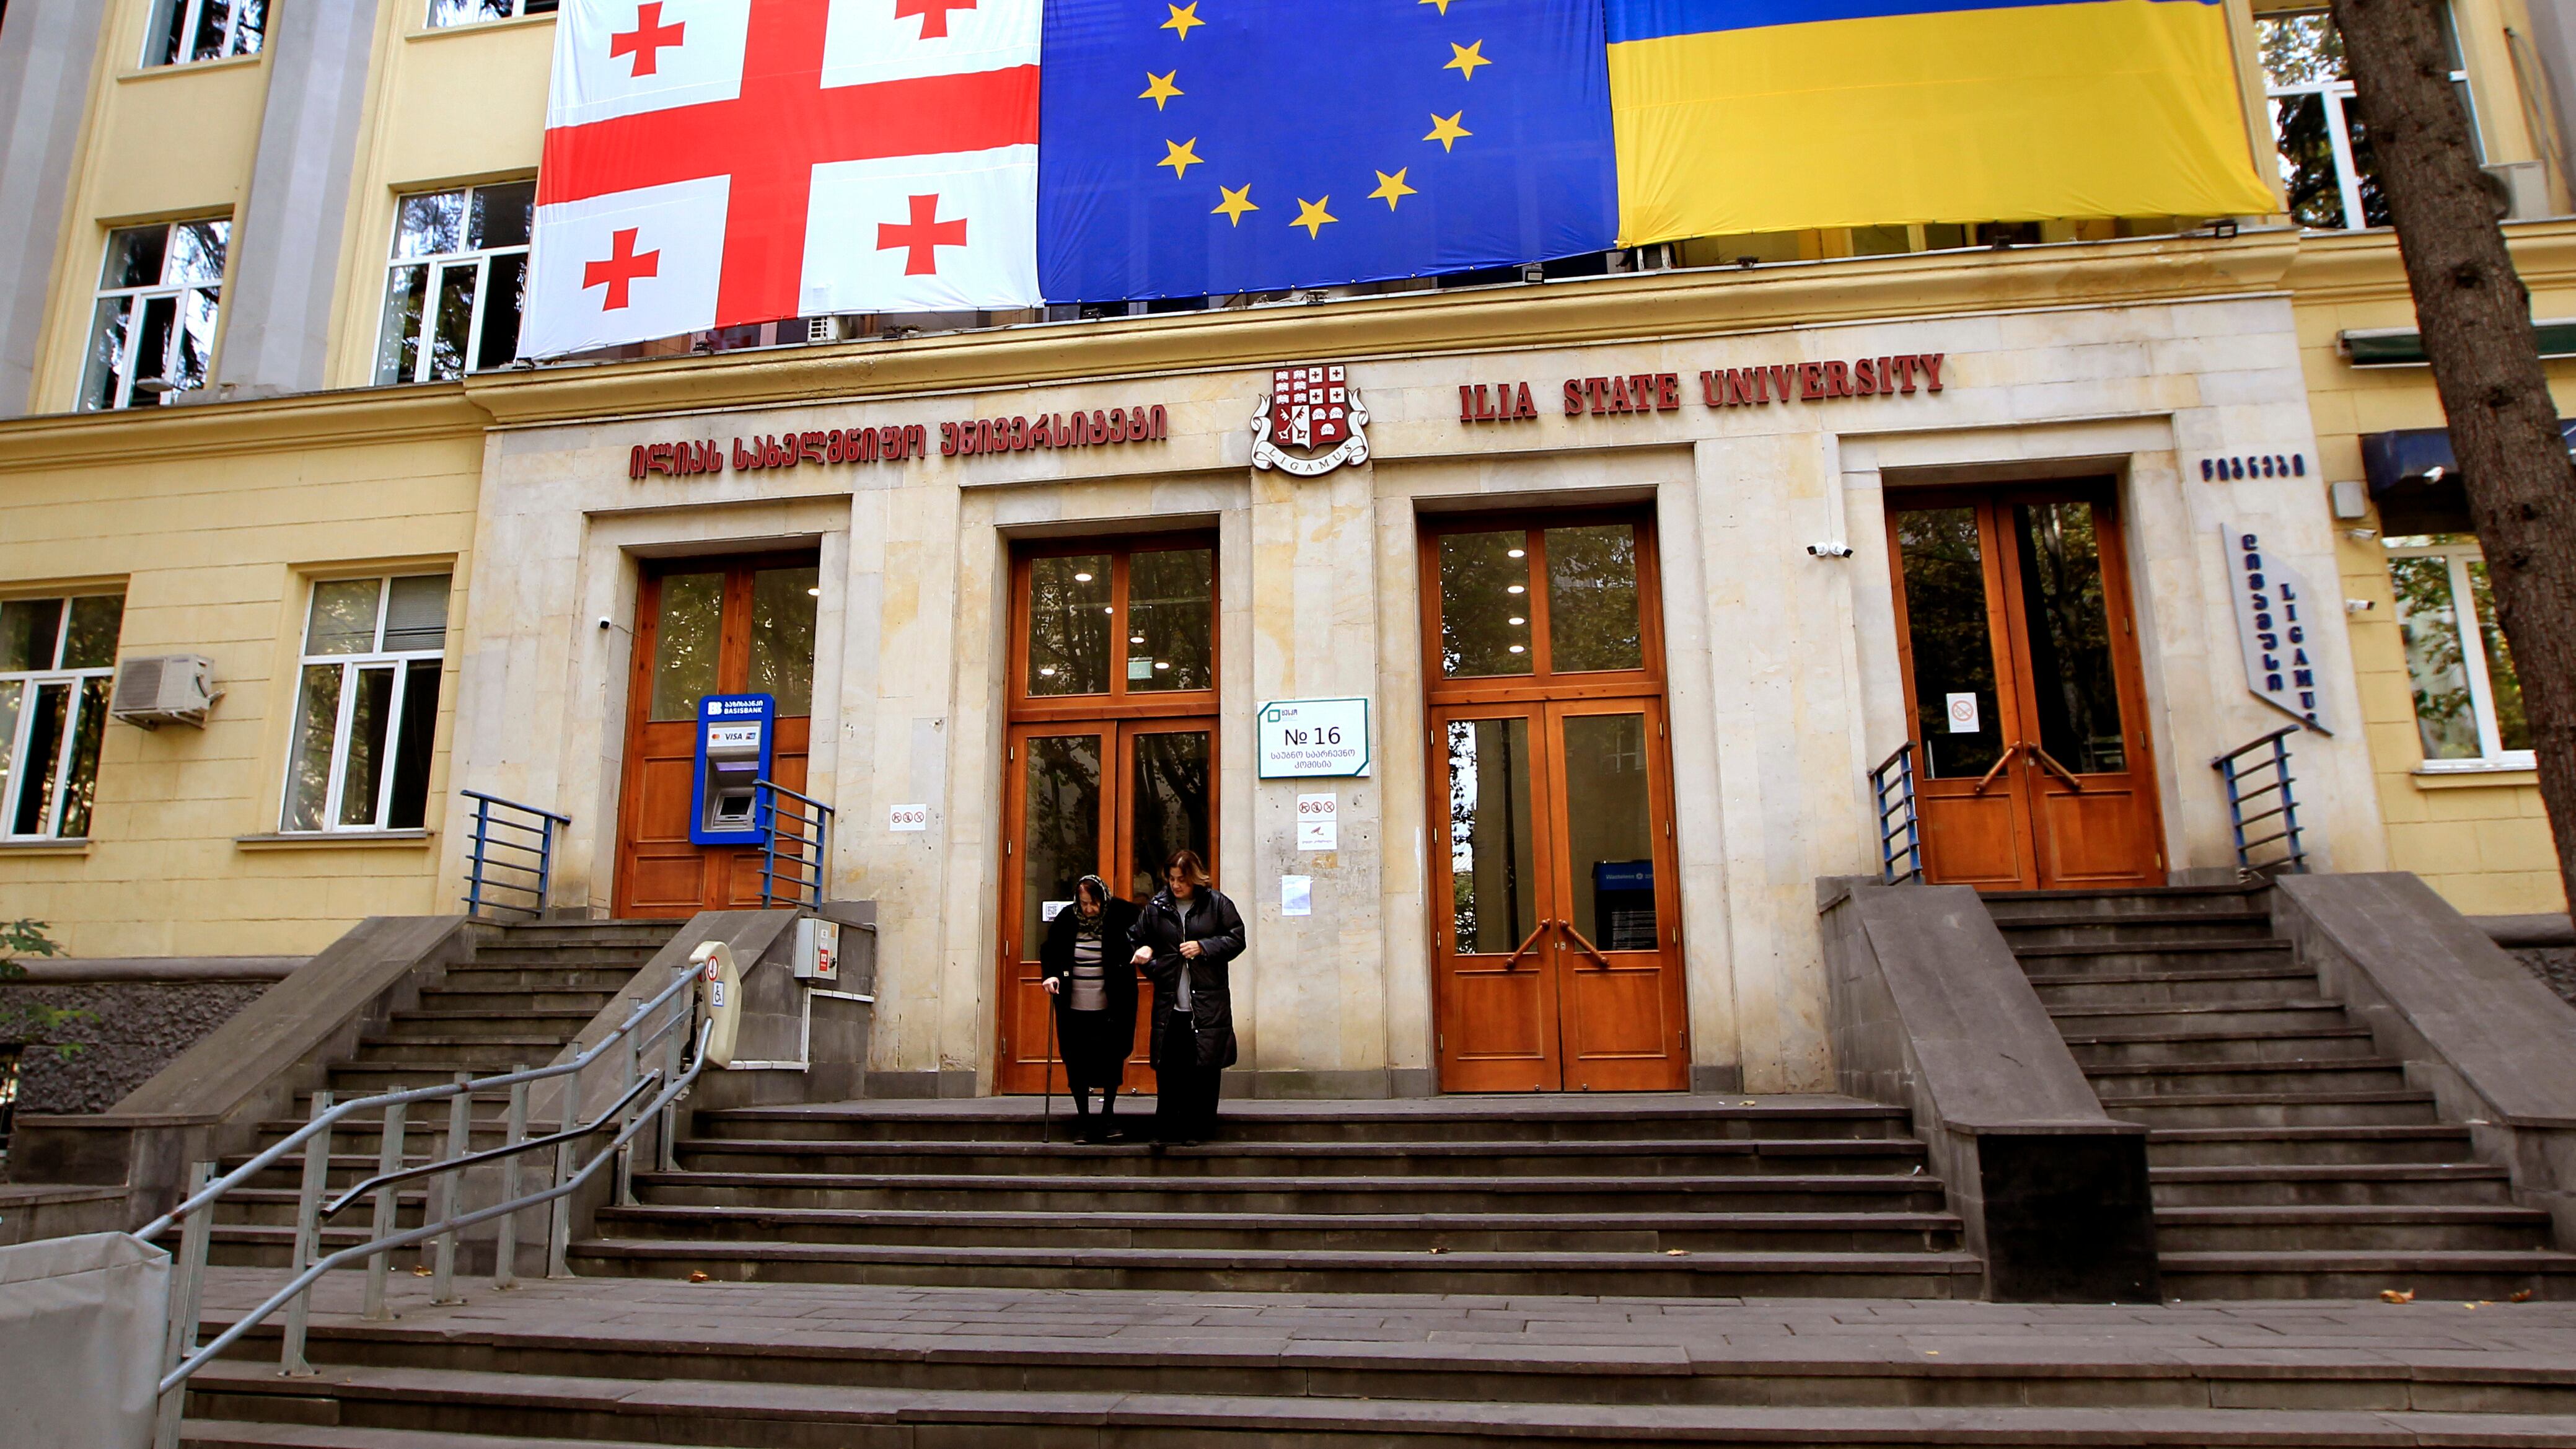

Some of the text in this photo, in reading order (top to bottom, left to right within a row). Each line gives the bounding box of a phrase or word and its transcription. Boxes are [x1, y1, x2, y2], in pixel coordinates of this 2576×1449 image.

[1459, 353, 1945, 423] ILIA STATE UNIVERSITY
[629, 404, 1167, 479] ილიას სახელმწიფო უნივერსიტეტი
[1268, 443, 1353, 472] LIGAMUS
[2280, 583, 2319, 731] LIGAMUS
[1314, 726, 1341, 745] 16
[1270, 749, 1355, 759] საუბნო საარჩევნო
[1295, 760, 1332, 769] კომისია
